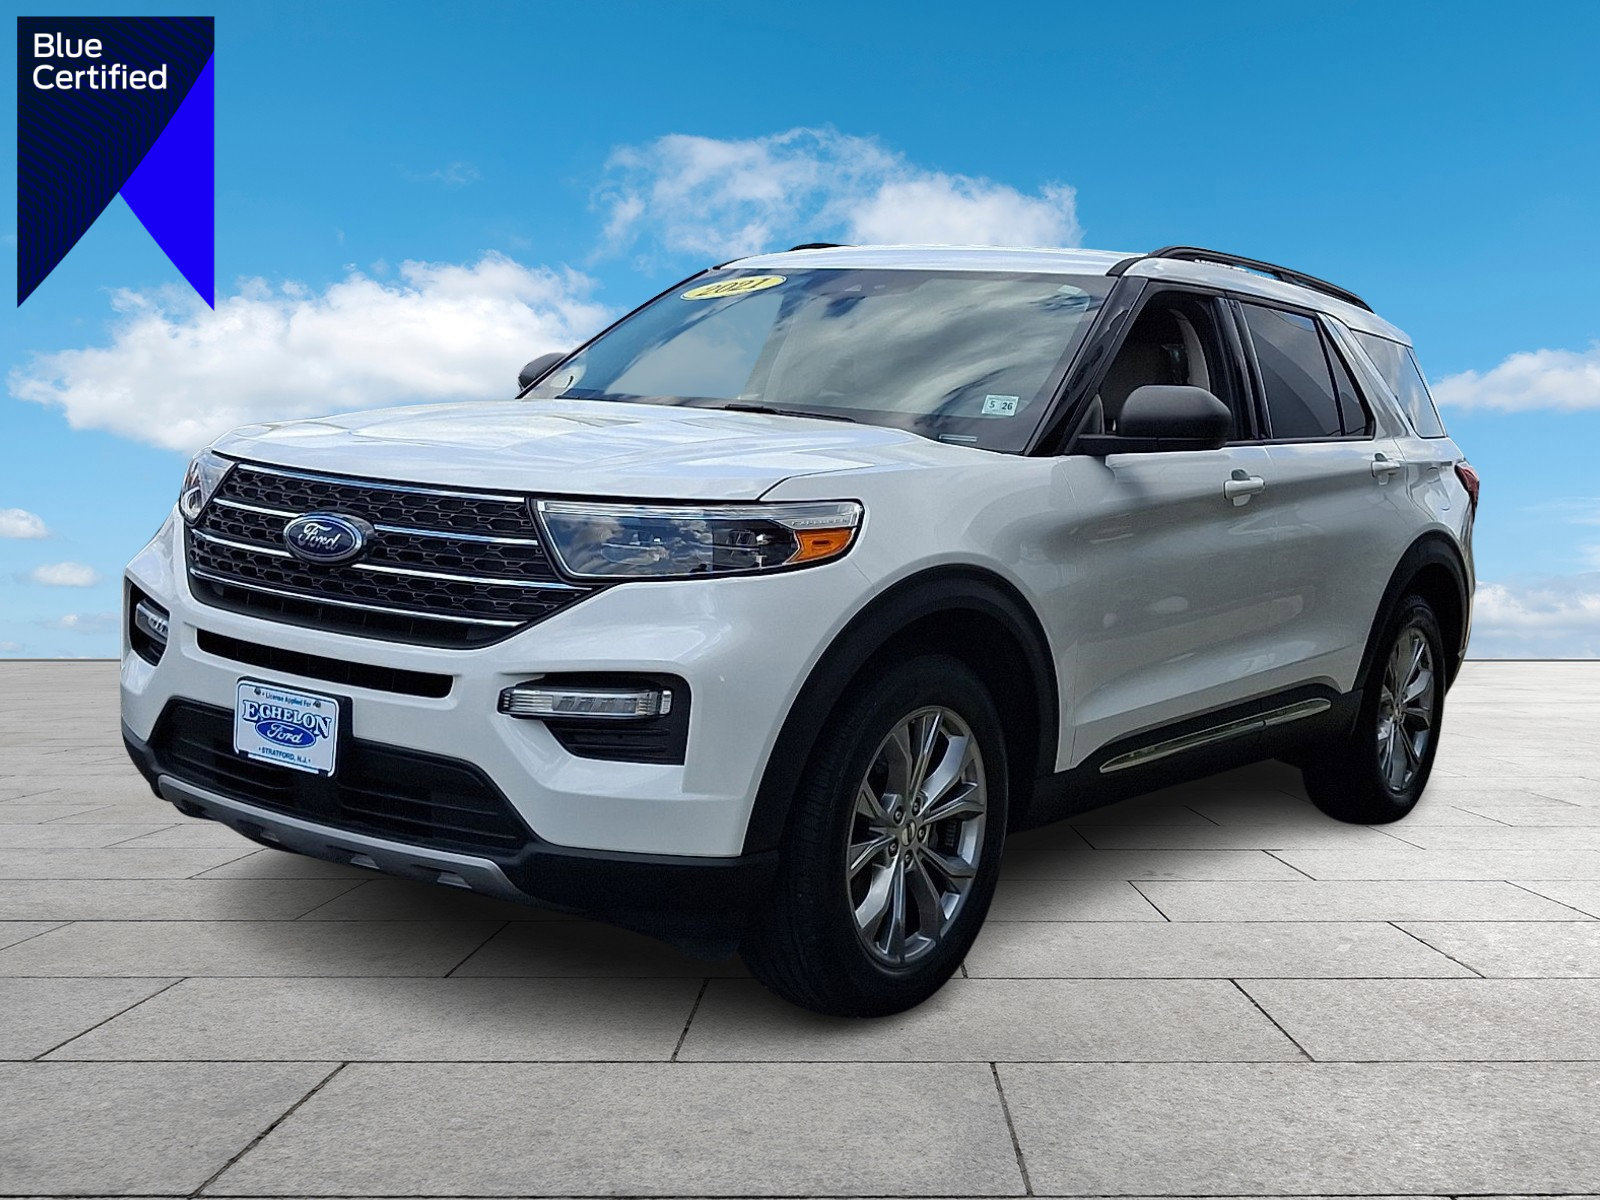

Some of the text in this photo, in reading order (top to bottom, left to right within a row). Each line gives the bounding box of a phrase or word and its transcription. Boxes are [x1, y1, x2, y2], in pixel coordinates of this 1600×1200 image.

[695, 277, 771, 297] 2021
[989, 400, 1014, 411] 5 26
[298, 522, 341, 551] Ford
[242, 700, 332, 739] ECHELON
[266, 722, 304, 744] Ford
